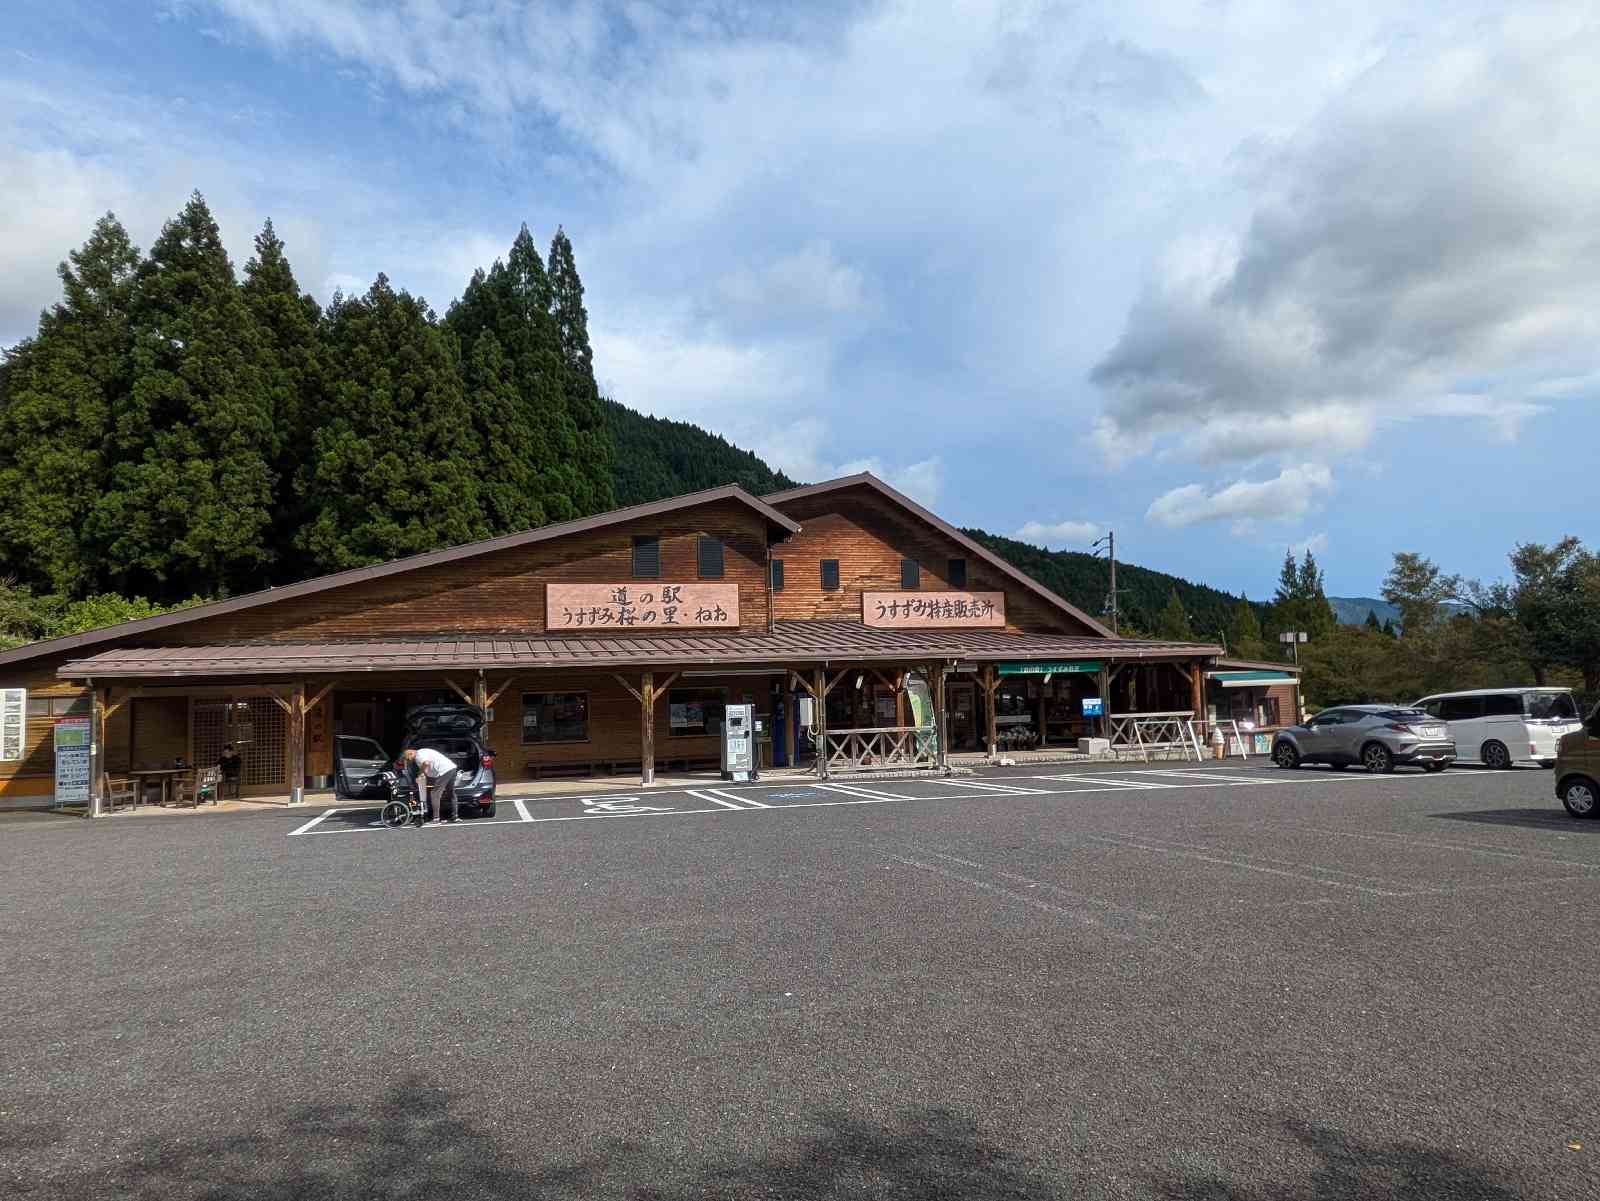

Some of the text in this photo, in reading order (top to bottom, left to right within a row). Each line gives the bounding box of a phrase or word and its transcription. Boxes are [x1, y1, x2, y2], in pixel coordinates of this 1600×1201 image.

[607, 586, 683, 605] 道の駅
[874, 598, 995, 620] うすずみ特産販売所
